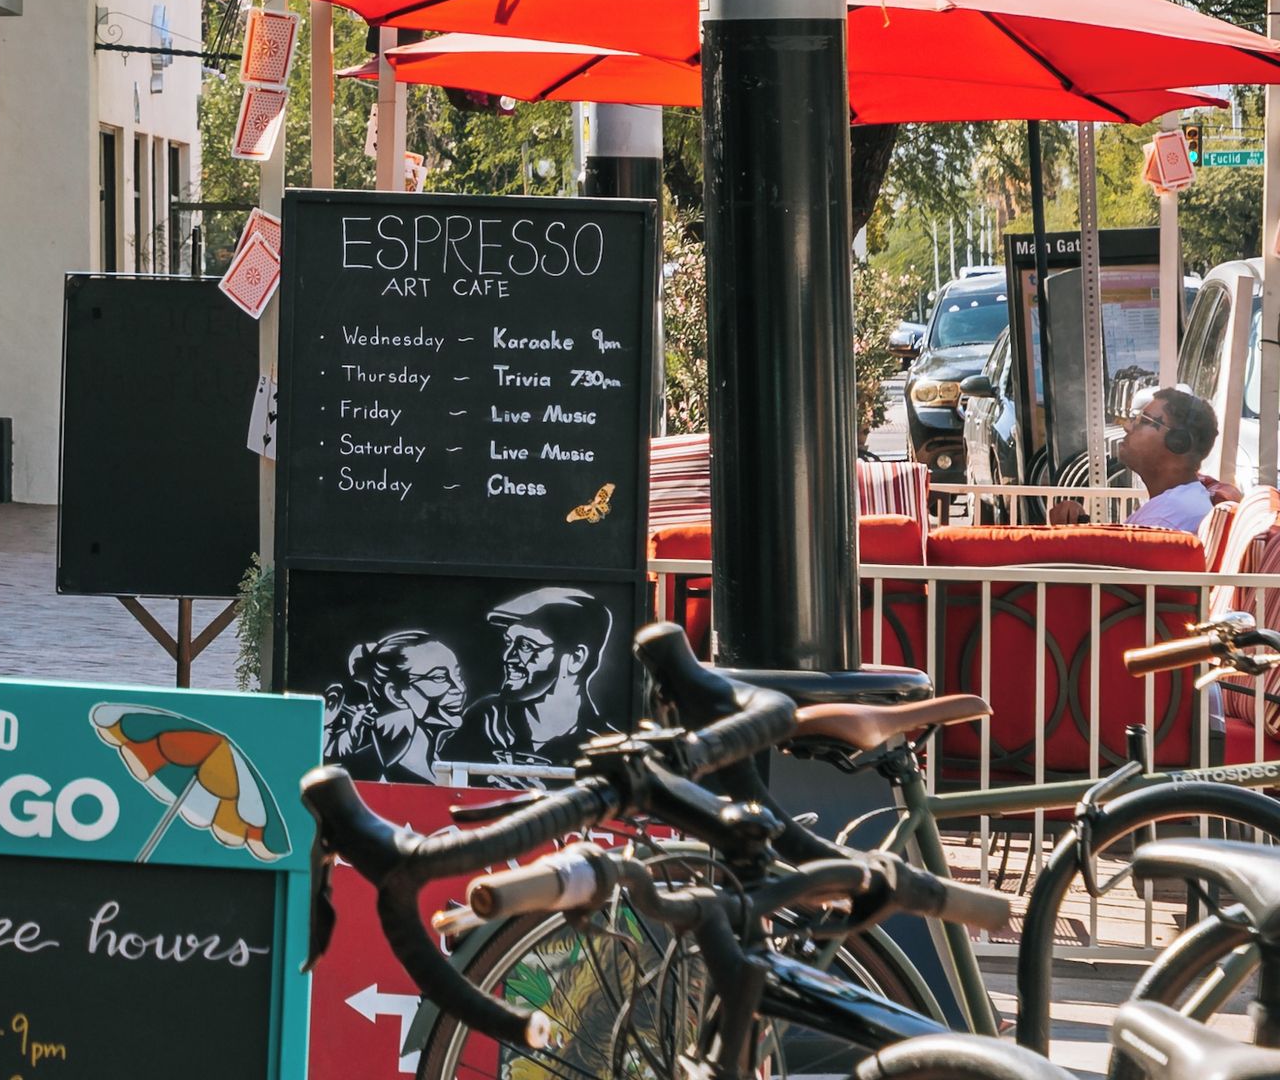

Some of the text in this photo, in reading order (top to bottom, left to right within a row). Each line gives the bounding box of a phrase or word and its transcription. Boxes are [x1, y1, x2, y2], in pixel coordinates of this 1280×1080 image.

[1210, 153, 1241, 166] Euclid
[342, 214, 604, 277] ESPRESSO
[1016, 238, 1081, 255] Man Gat
[381, 277, 510, 298] ART CAFE
[342, 325, 622, 354] Wednesday Karaoke 9pm
[341, 364, 431, 392] Thursday
[493, 364, 551, 387] Trivia
[340, 400, 597, 426] Friday Live Music
[340, 433, 595, 462] Saturday Live Music
[338, 467, 547, 500] Sunday Chess
[88, 901, 272, 968] hours
